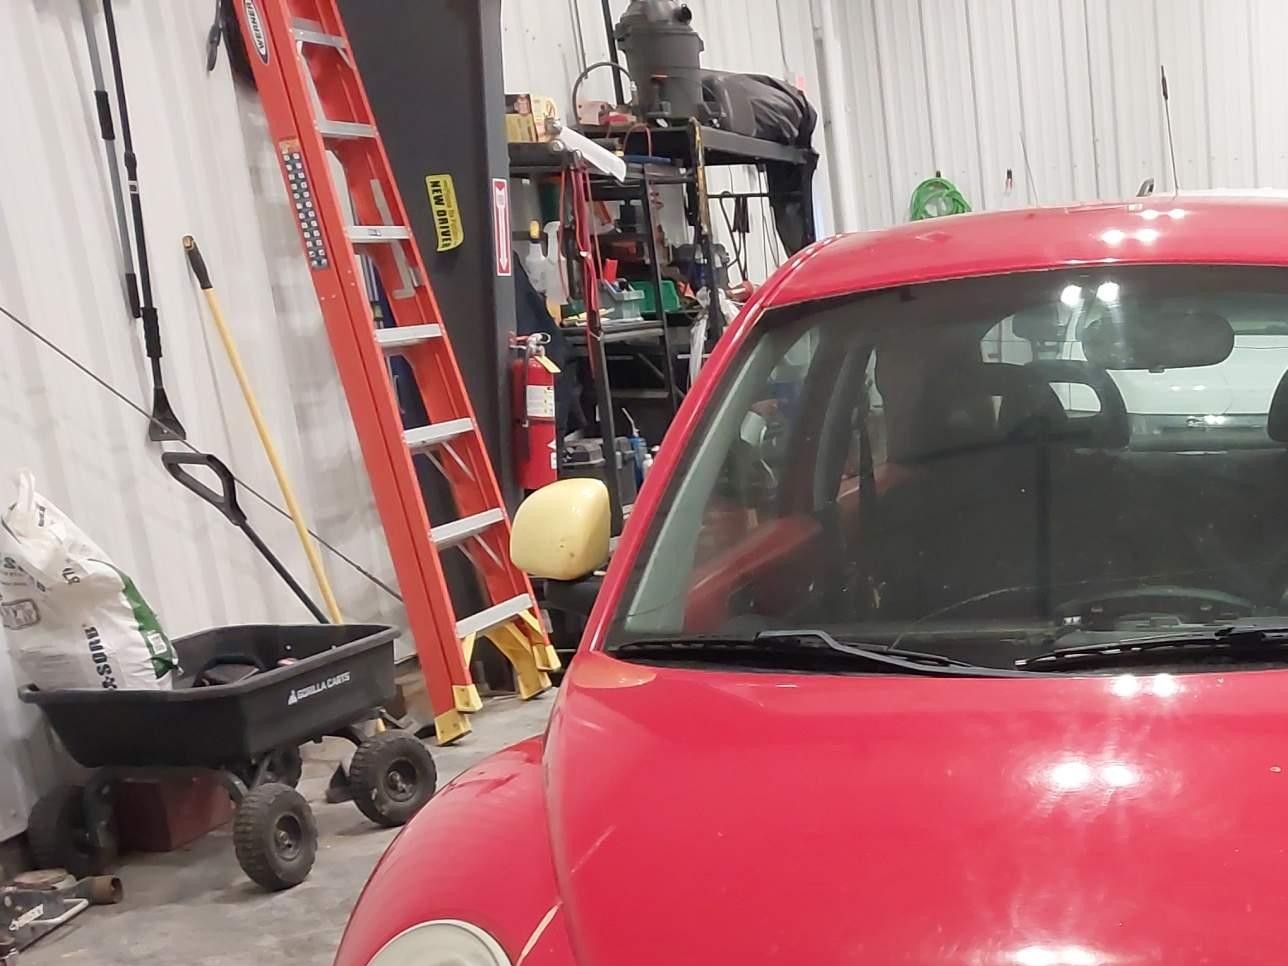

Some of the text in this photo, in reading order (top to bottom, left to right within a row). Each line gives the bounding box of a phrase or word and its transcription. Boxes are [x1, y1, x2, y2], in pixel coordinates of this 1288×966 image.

[246, 2, 265, 49] WERNER
[430, 180, 446, 207] NEW
[436, 209, 453, 249] DRIVER
